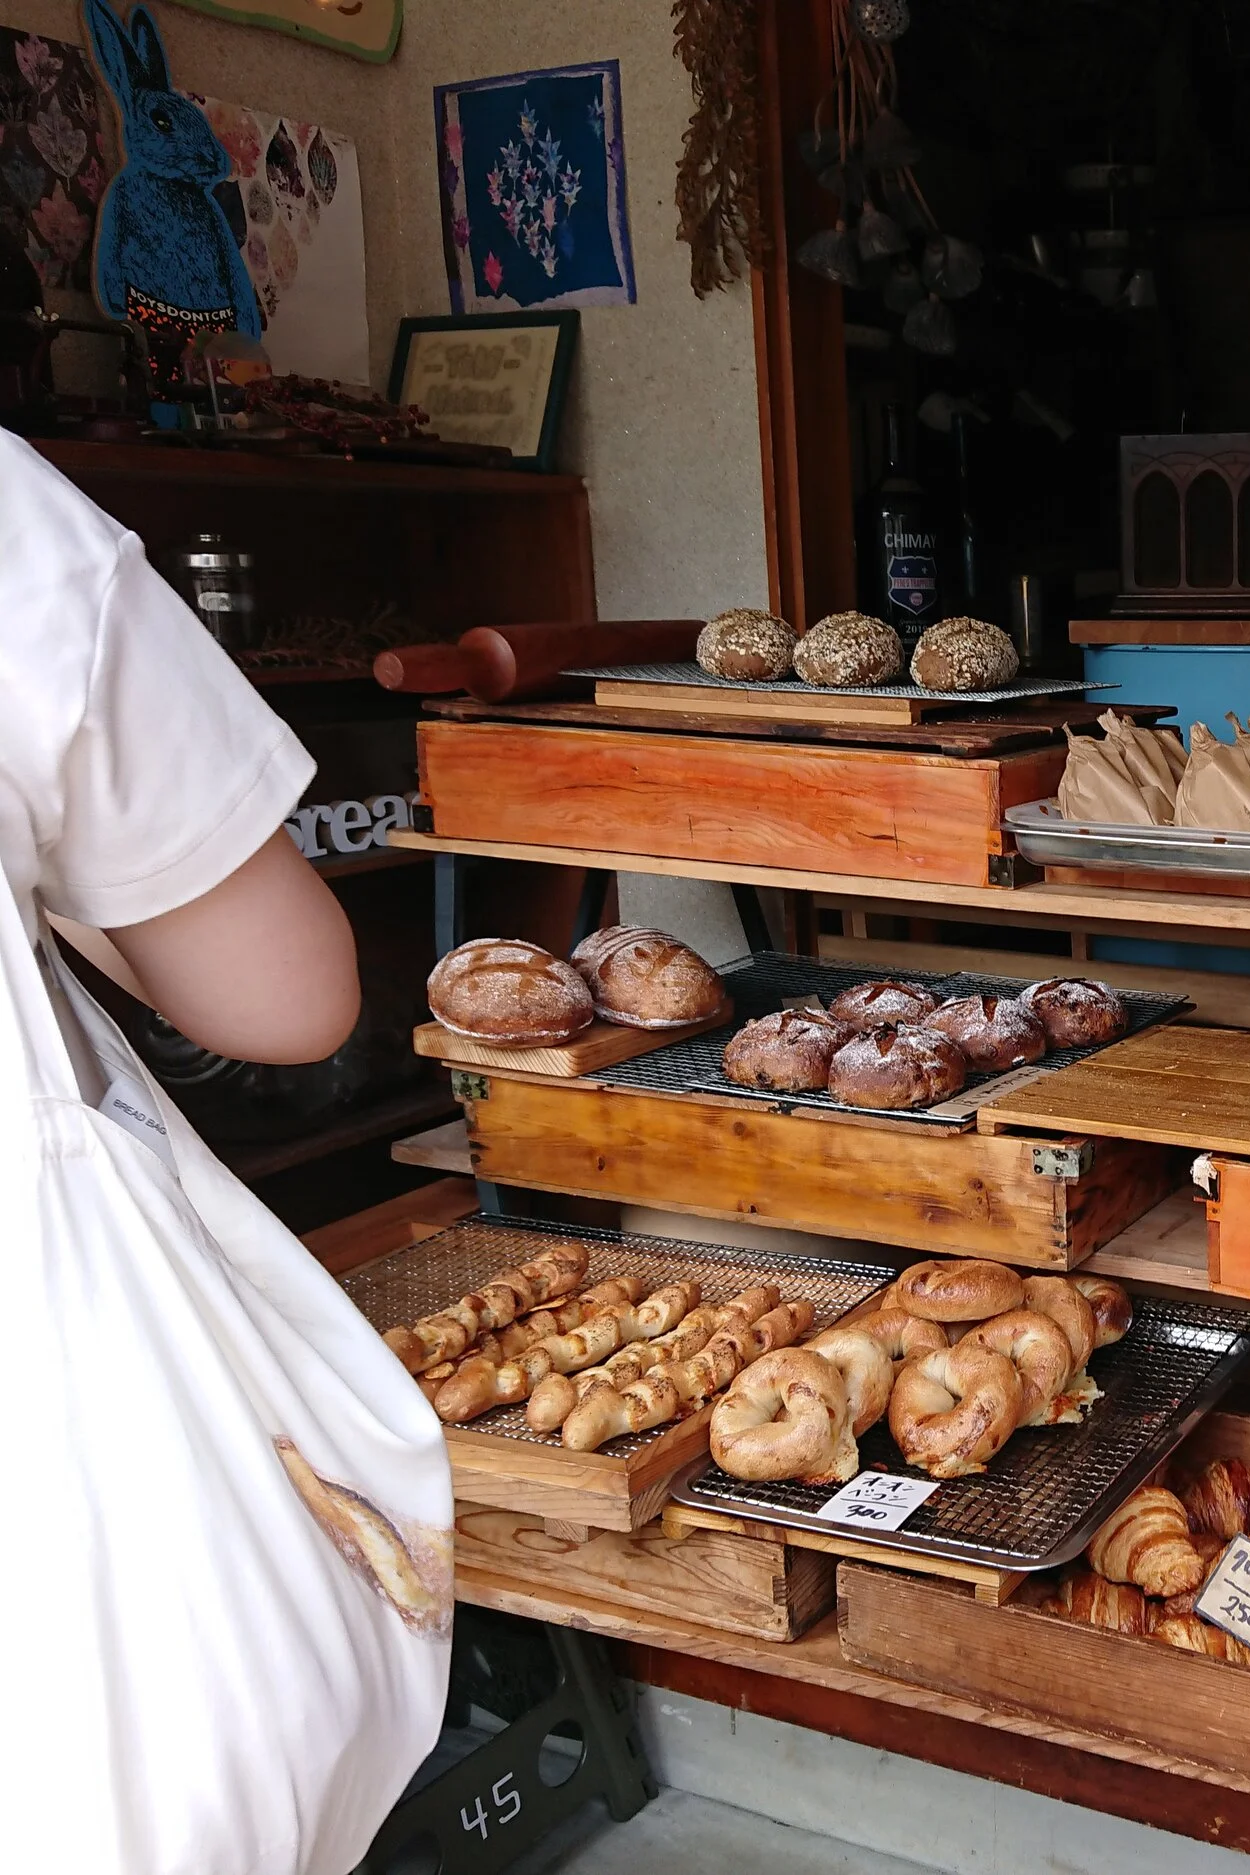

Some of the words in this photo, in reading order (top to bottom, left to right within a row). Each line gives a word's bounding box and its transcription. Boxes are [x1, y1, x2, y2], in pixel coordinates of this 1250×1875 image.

[884, 533, 937, 549] CHIMAY
[284, 791, 421, 858] rea
[113, 1098, 146, 1122] BREAD
[145, 1118, 167, 1135] BAG
[460, 1771, 521, 1840] 45
